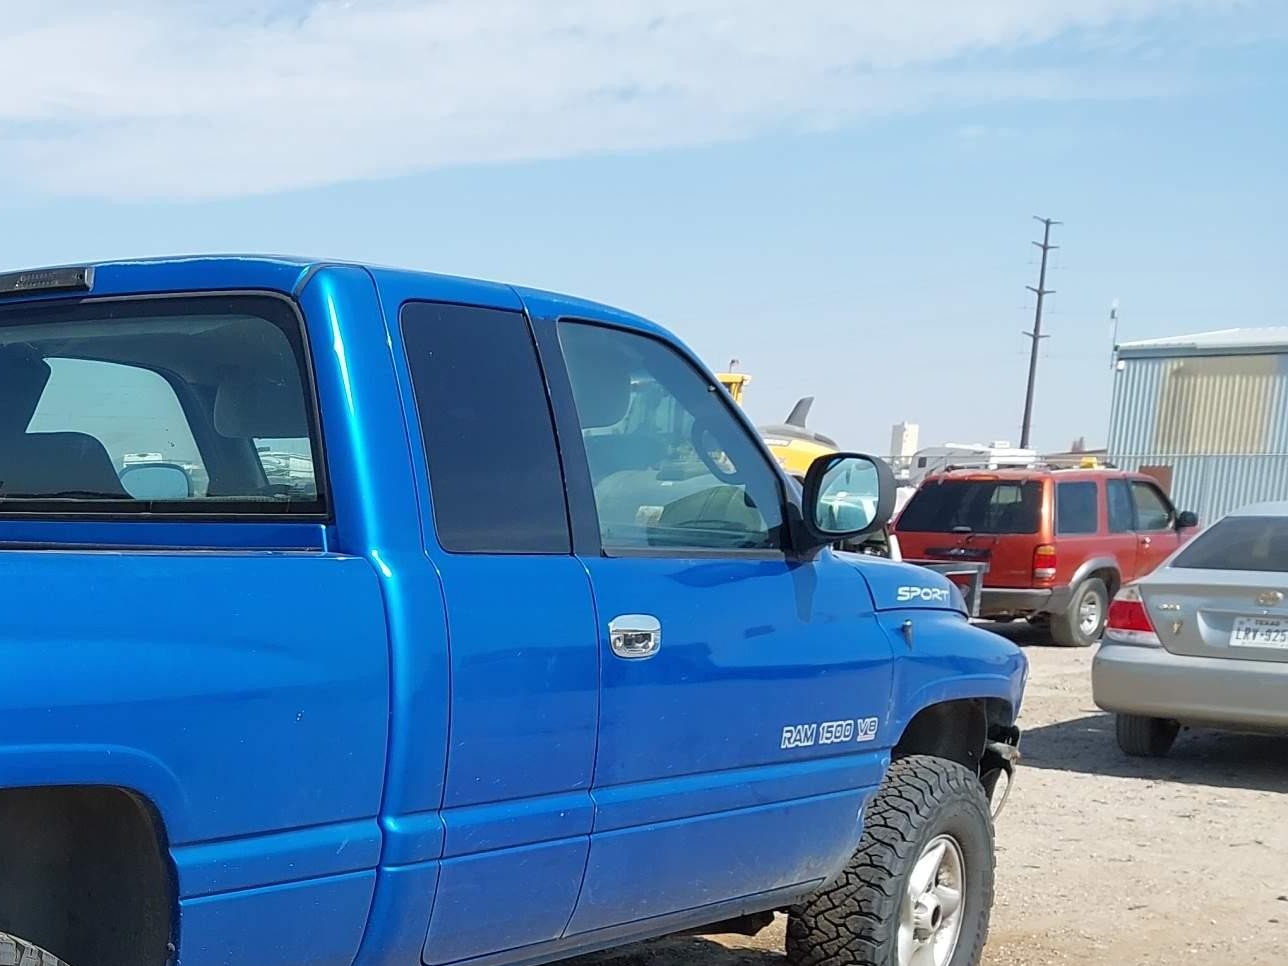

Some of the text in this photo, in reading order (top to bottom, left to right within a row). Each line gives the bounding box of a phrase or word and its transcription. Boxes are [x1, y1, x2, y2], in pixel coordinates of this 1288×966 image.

[897, 586, 950, 601] SPORT
[780, 717, 878, 749] RAM 1500 V8
